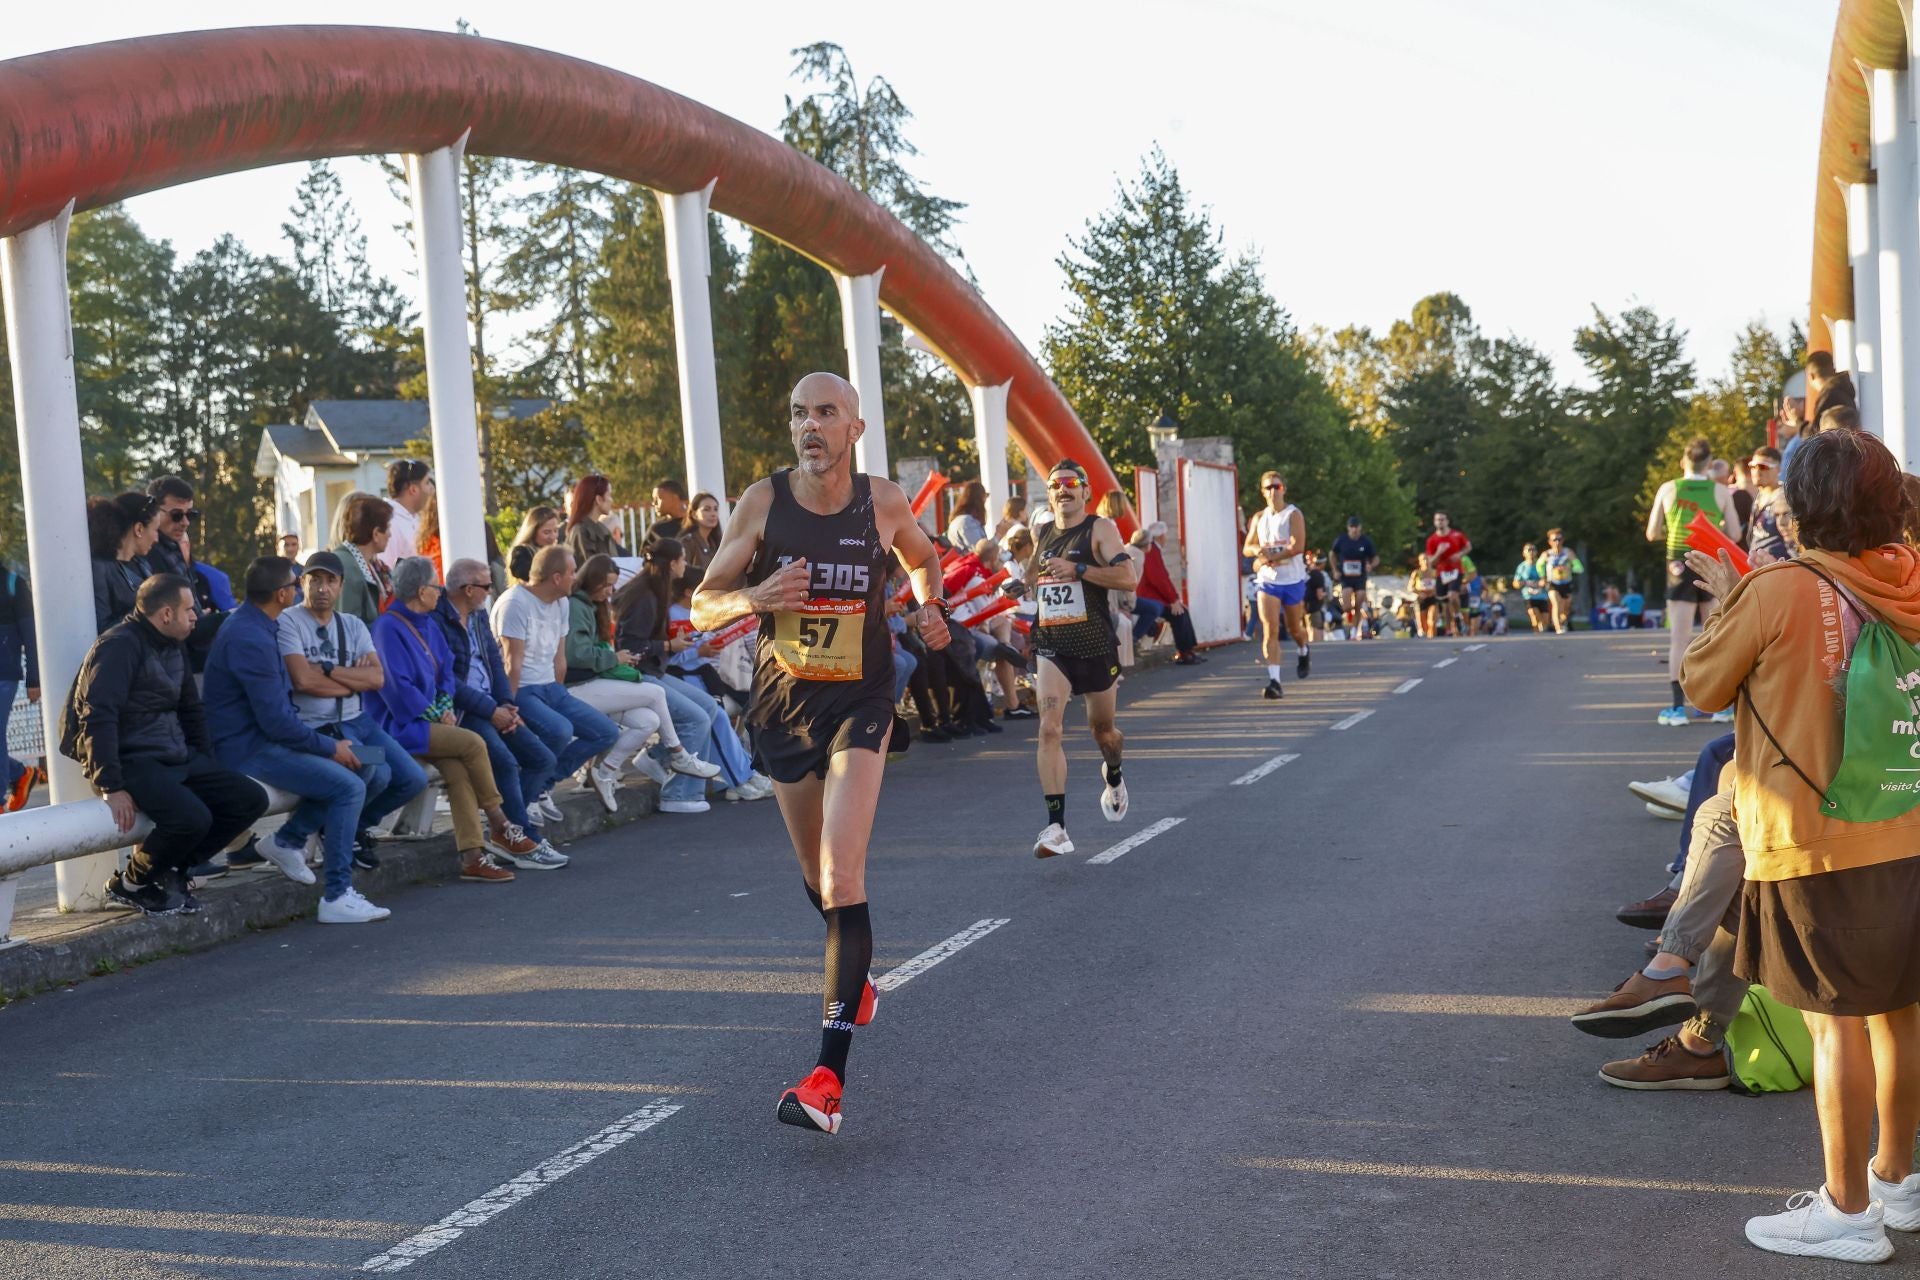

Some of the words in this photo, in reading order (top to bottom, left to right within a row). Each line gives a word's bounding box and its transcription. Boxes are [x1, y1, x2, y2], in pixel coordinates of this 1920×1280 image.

[1042, 585, 1074, 606] 432
[1817, 579, 1835, 608] MIND
[1822, 610, 1837, 626] OF
[799, 617, 839, 648] 57
[1824, 630, 1840, 654] OUT
[1880, 781, 1912, 791] visita
